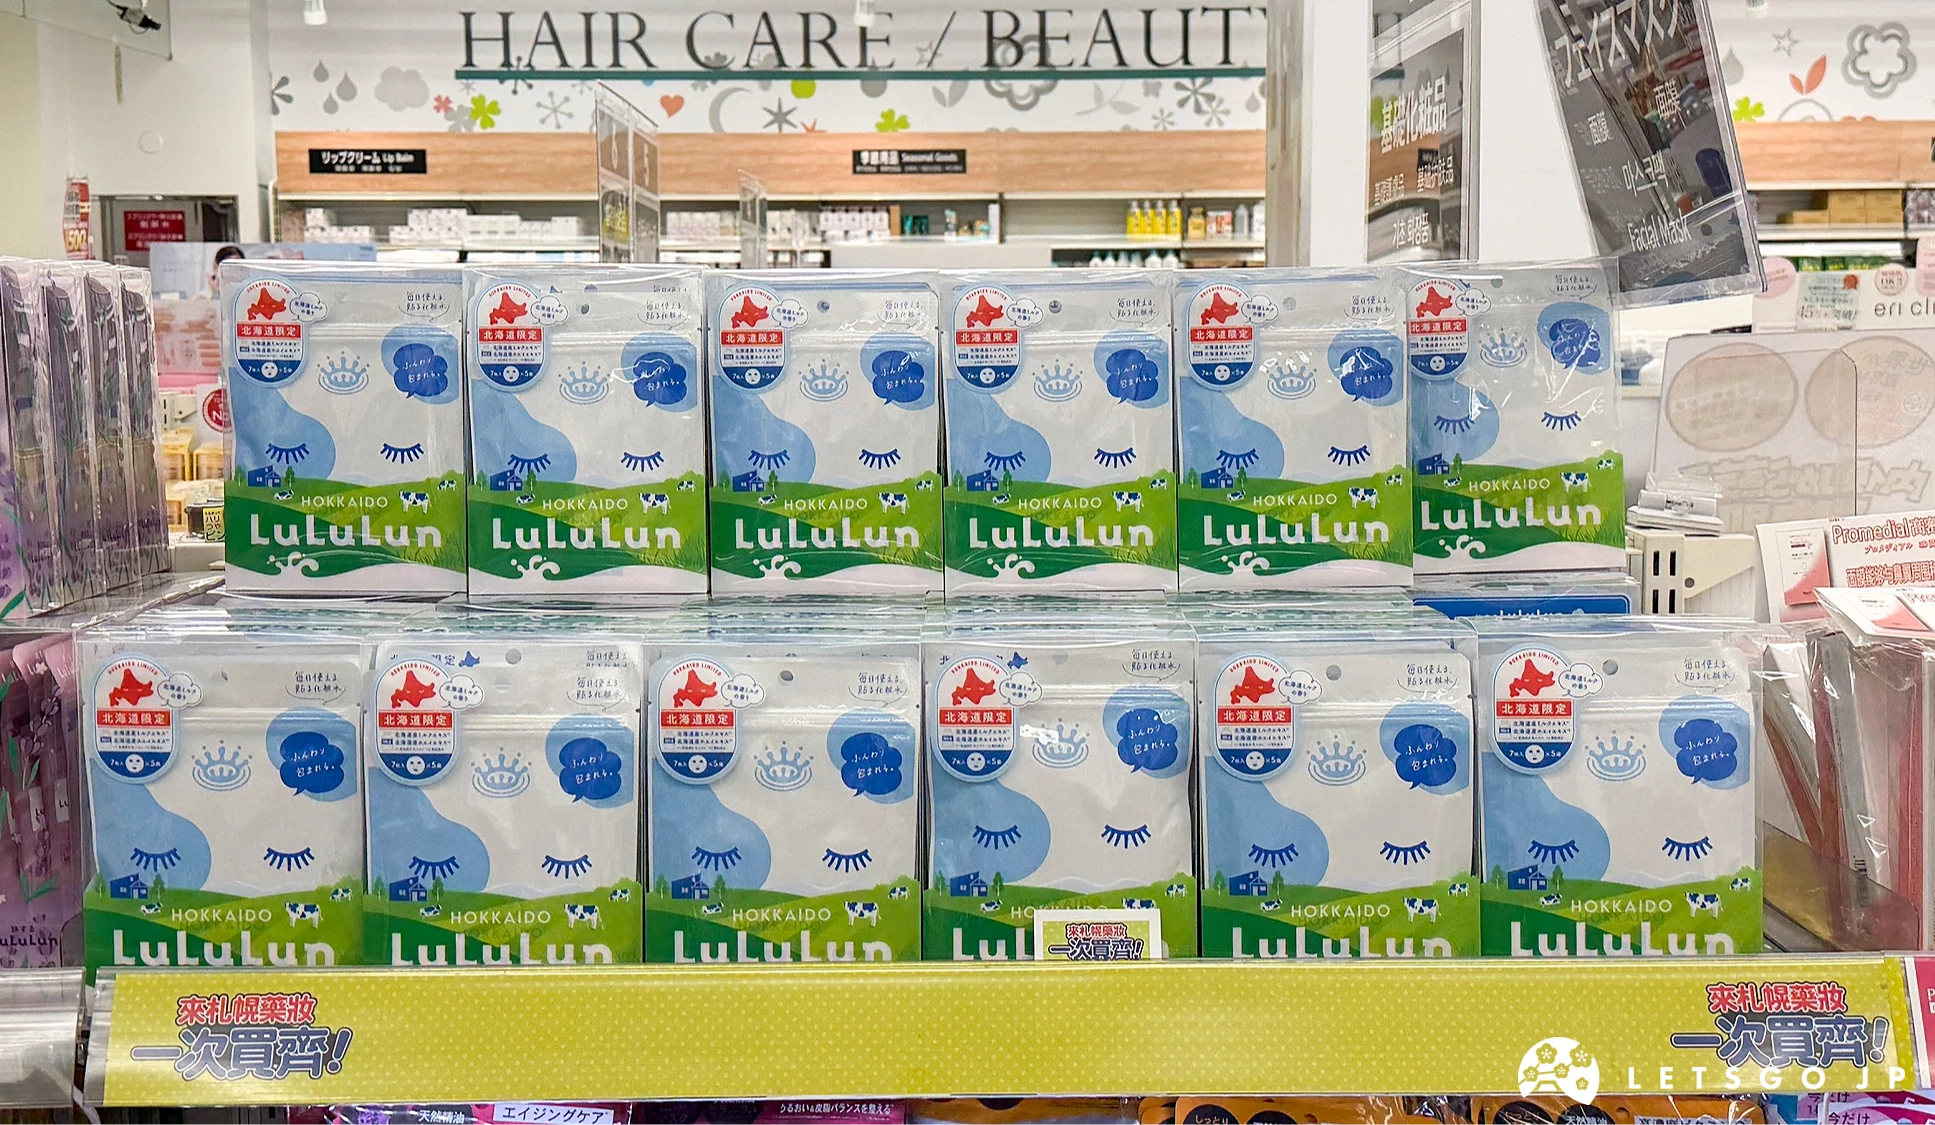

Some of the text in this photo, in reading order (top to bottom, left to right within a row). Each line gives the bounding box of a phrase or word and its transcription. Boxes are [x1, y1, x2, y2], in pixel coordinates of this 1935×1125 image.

[459, 10, 659, 68] HAIR
[686, 10, 895, 69] CARE
[984, 6, 1266, 69] BEAUT
[1381, 75, 1448, 154] 基礎化粧品
[321, 151, 381, 165] リップクリーム
[1627, 207, 1692, 253] Facial Mask
[241, 326, 296, 336] 北海道限定
[1410, 321, 1463, 331] 北海道限定
[483, 330, 538, 340] 北海道限定
[726, 332, 779, 343] 北海道限定
[961, 332, 1014, 342] 北海道限定
[1195, 329, 1249, 339] 北海道限定
[1468, 477, 1551, 492] HOKKAIDO
[300, 494, 390, 509] HOKKAIDO
[541, 497, 629, 512] HOKKAIDO
[783, 497, 869, 512] HOKKAIDO
[1017, 496, 1103, 511] HOKKAIDO
[1252, 493, 1338, 508] HOKKAIDO
[1421, 497, 1601, 530] LuLuLun
[250, 514, 442, 548] LuLuLun
[493, 517, 681, 550] LuLuLun
[735, 518, 920, 550] LuLuLun
[969, 516, 1154, 549] LuLuLun
[1203, 514, 1389, 546] LuLuLun
[1223, 710, 1286, 722] 北海道限定
[1501, 703, 1567, 715] 北海道限定
[102, 712, 166, 725] 北海道限定
[384, 714, 447, 726] 北海道限定
[666, 713, 729, 725] 北海道限定
[945, 712, 1007, 723] 北海道限定
[1290, 903, 1391, 918] HOKKAIDO
[1570, 898, 1673, 914] HOKKAIDO
[171, 907, 273, 923] HOKKAIDO
[450, 910, 552, 925] HOKKAIDO
[732, 907, 832, 922] HOKKAIDO
[674, 930, 892, 963] LuLuLun
[1232, 926, 1453, 959] LuLuLun
[1510, 921, 1737, 957] LuLuLun
[113, 929, 335, 966] LuLuLun
[391, 932, 613, 966] LuLuLun
[1671, 1015, 1889, 1068] 一次買齊!
[131, 1027, 354, 1081] 一次買齊!
